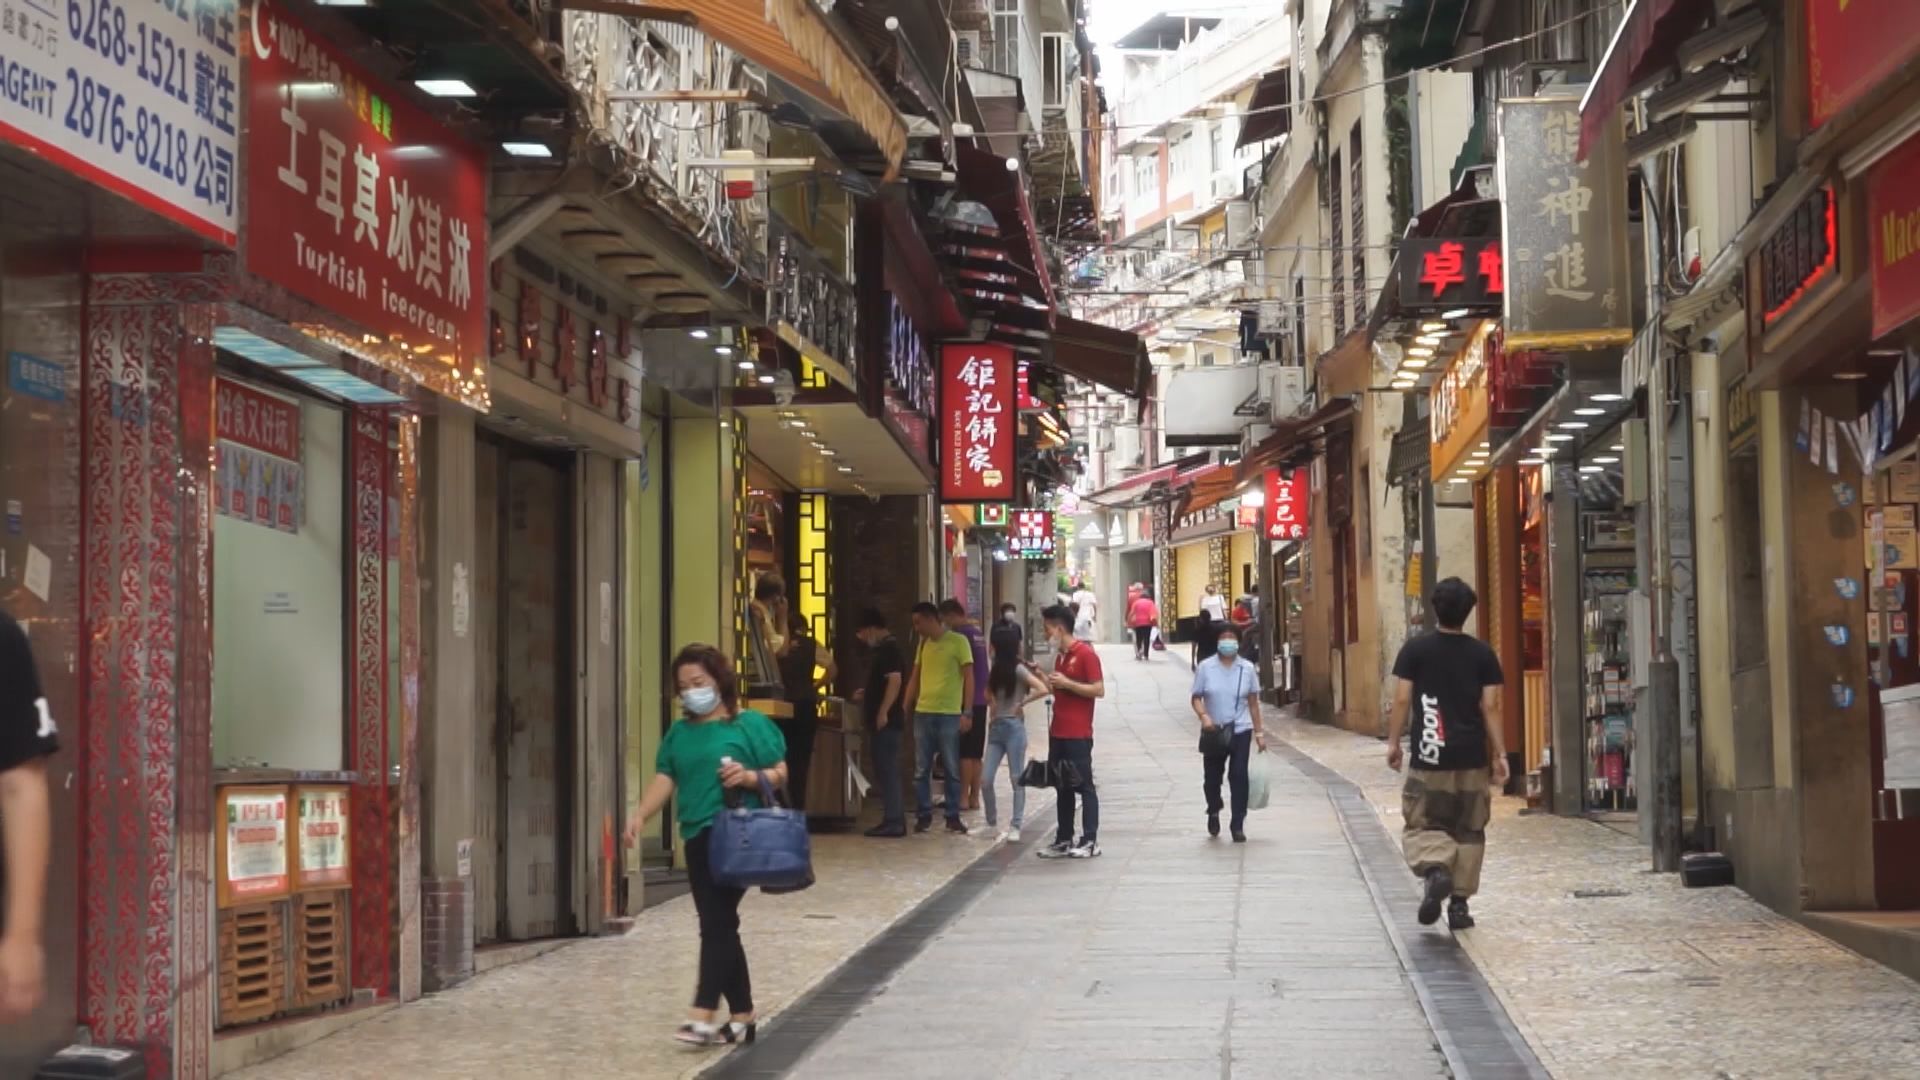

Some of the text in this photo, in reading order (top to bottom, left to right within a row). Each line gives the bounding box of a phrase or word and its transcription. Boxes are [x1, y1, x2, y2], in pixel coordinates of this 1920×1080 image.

[66, 0, 188, 104] 6268-1521
[64, 67, 189, 186] 2876-8218
[194, 136, 234, 217] 公司
[277, 88, 471, 310] 土耳其冰淇淋
[293, 231, 367, 299] Turkish
[957, 355, 1002, 473] 鉅記餅家
[1418, 693, 1446, 765] iSport
